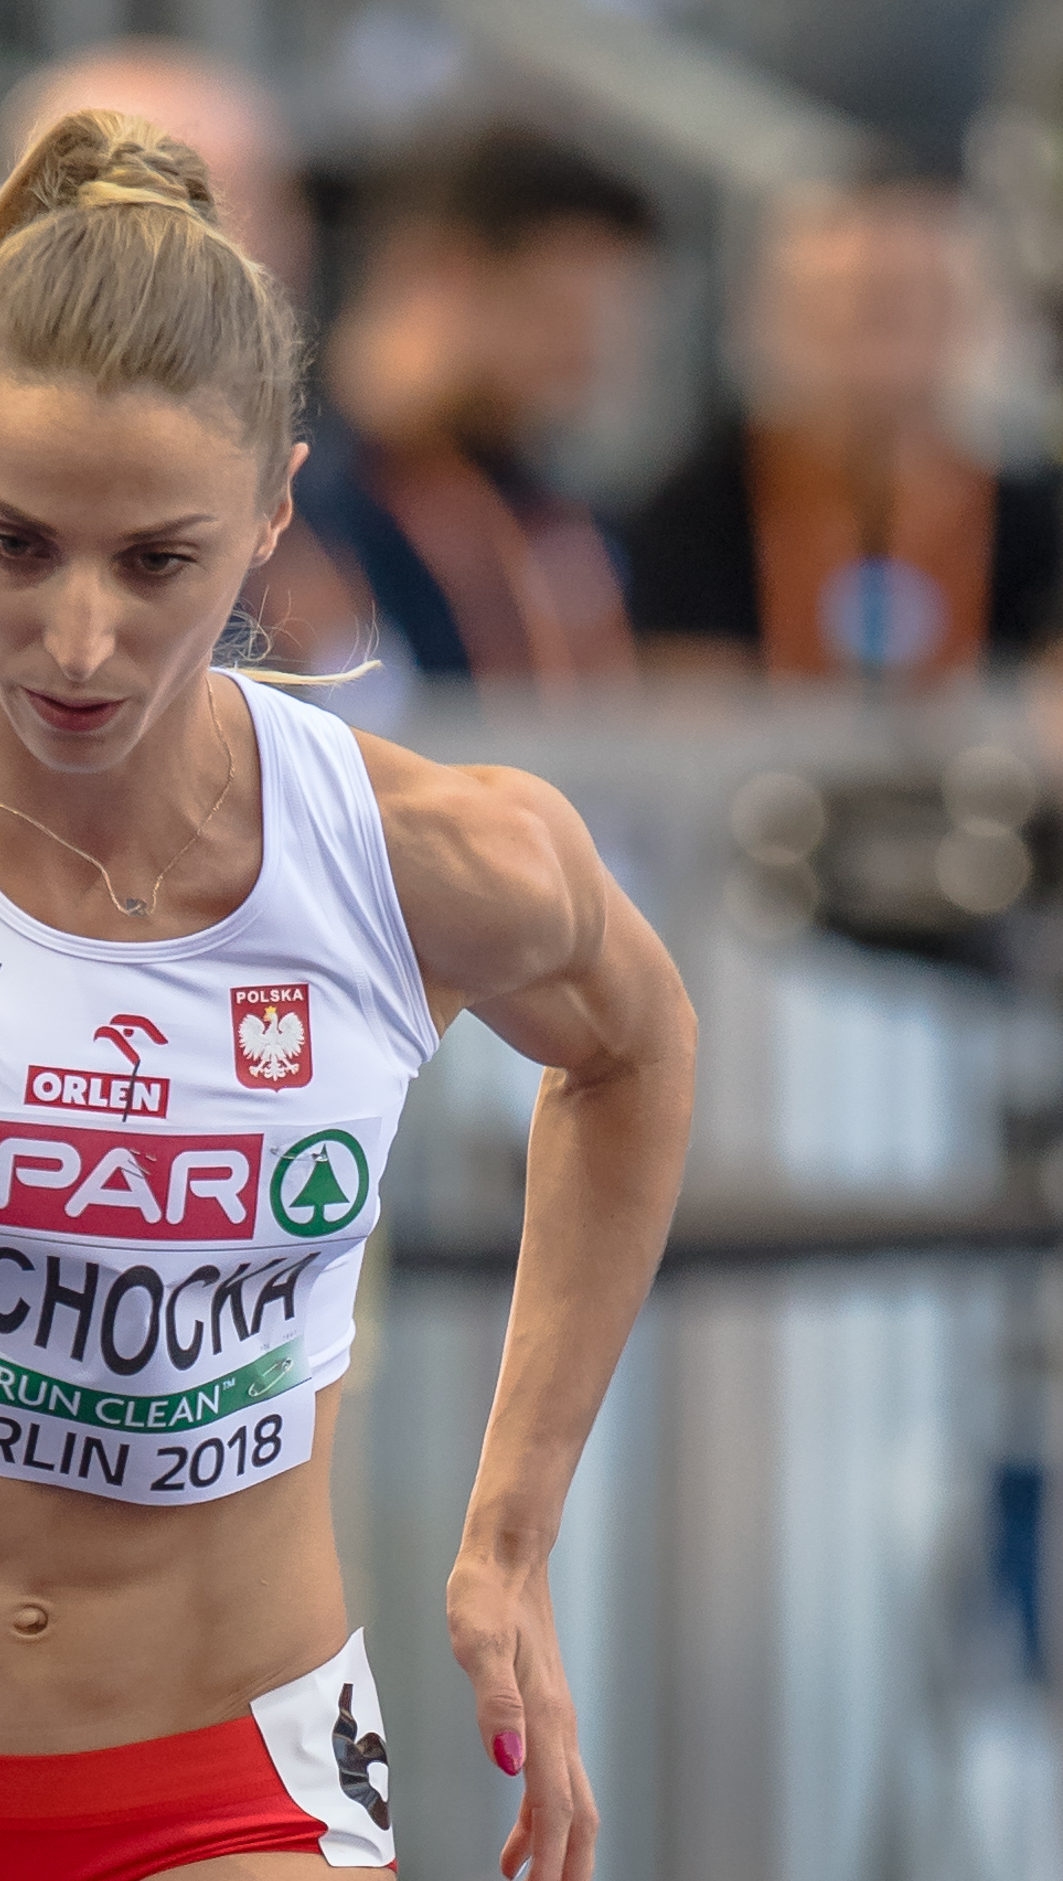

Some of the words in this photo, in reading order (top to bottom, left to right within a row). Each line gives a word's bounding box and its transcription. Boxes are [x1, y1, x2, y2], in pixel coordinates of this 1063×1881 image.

[236, 987, 304, 1005] POLSKA
[32, 1071, 162, 1112] ORLEN
[149, 1413, 283, 1492] 2018
